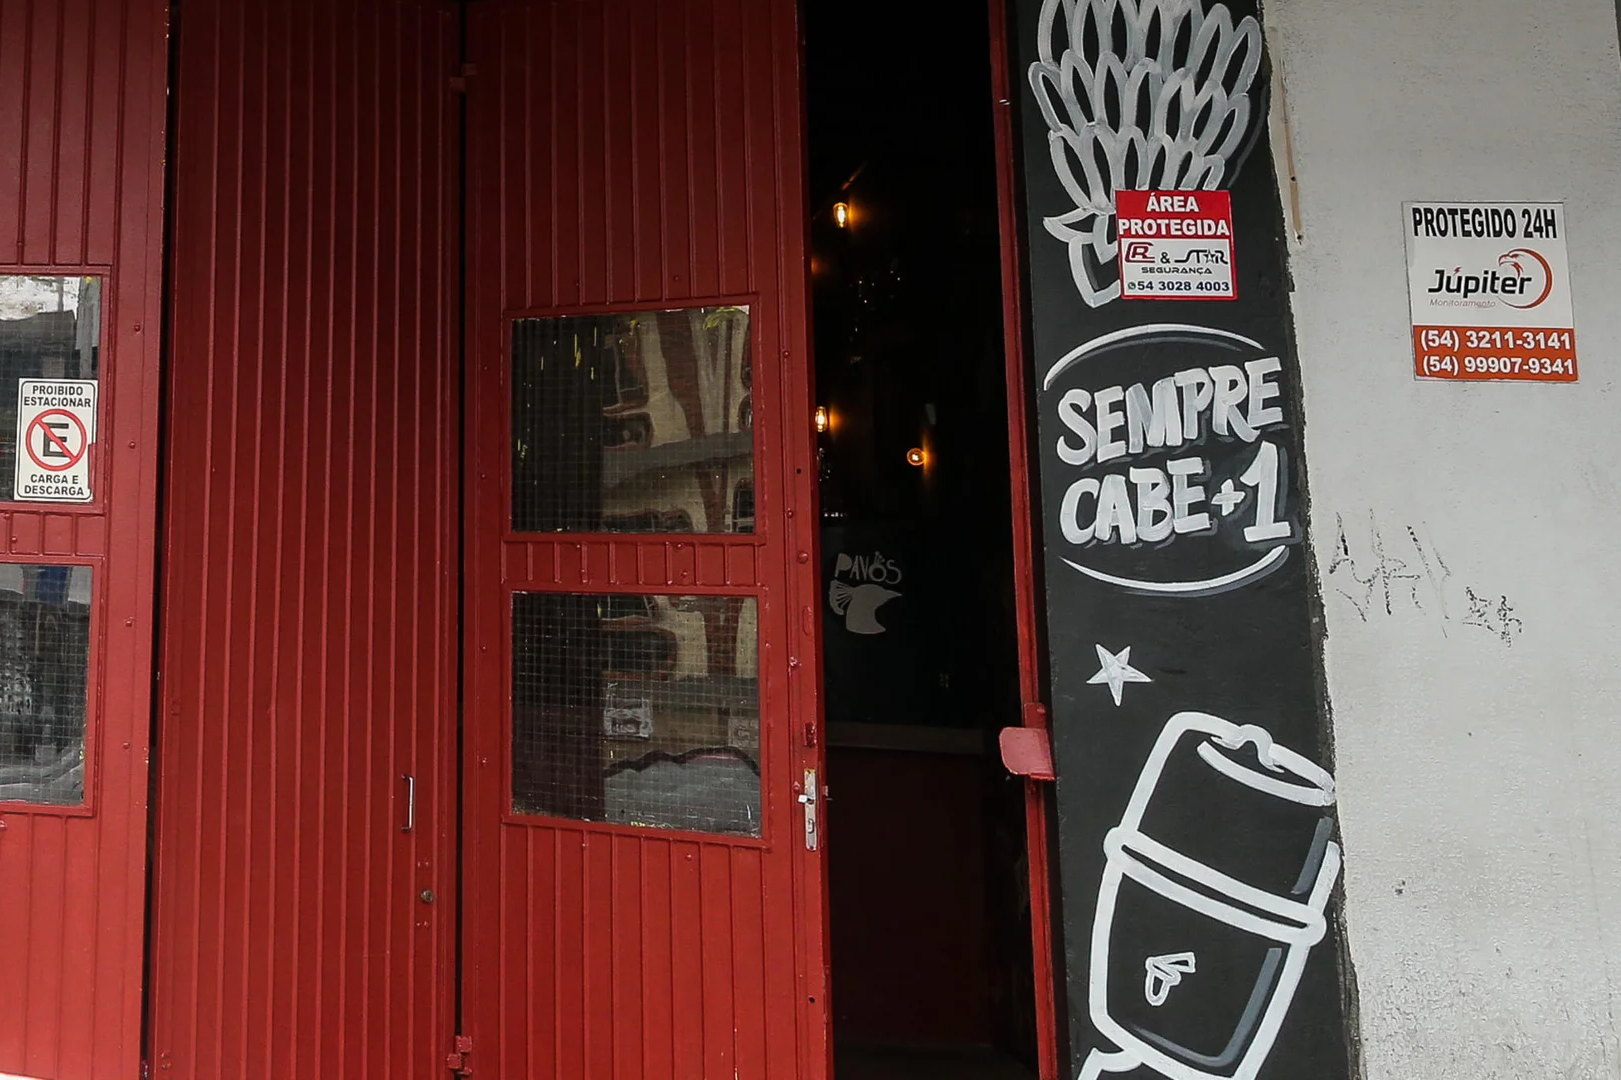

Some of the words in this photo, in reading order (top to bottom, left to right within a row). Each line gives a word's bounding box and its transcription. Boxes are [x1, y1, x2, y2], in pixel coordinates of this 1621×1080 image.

[1146, 192, 1200, 212] ÁREA
[1118, 218, 1230, 236] PROTEGIDA
[1411, 207, 1517, 238] PROTEGIDO
[1521, 208, 1557, 239] 24H
[1160, 252, 1170, 264] &
[1141, 267, 1212, 275] SEGURANÇA
[1137, 281, 1154, 291] 54
[1158, 281, 1192, 291] 3028
[1196, 281, 1230, 292] 4003
[1428, 266, 1532, 298] Júpiter
[1429, 298, 1496, 309] Monitoramento
[1420, 330, 1460, 351] (54)
[1465, 330, 1571, 350] 3211-3141
[1422, 356, 1459, 375] (54)
[1464, 356, 1574, 375] 99907-9341
[32, 385, 84, 396] PROIBIDO
[23, 396, 91, 408] ESTACIONAR
[1056, 356, 1283, 465] SEMPRE
[30, 474, 68, 484] CARGA
[72, 475, 79, 485] E
[24, 485, 84, 496] DESCARGA
